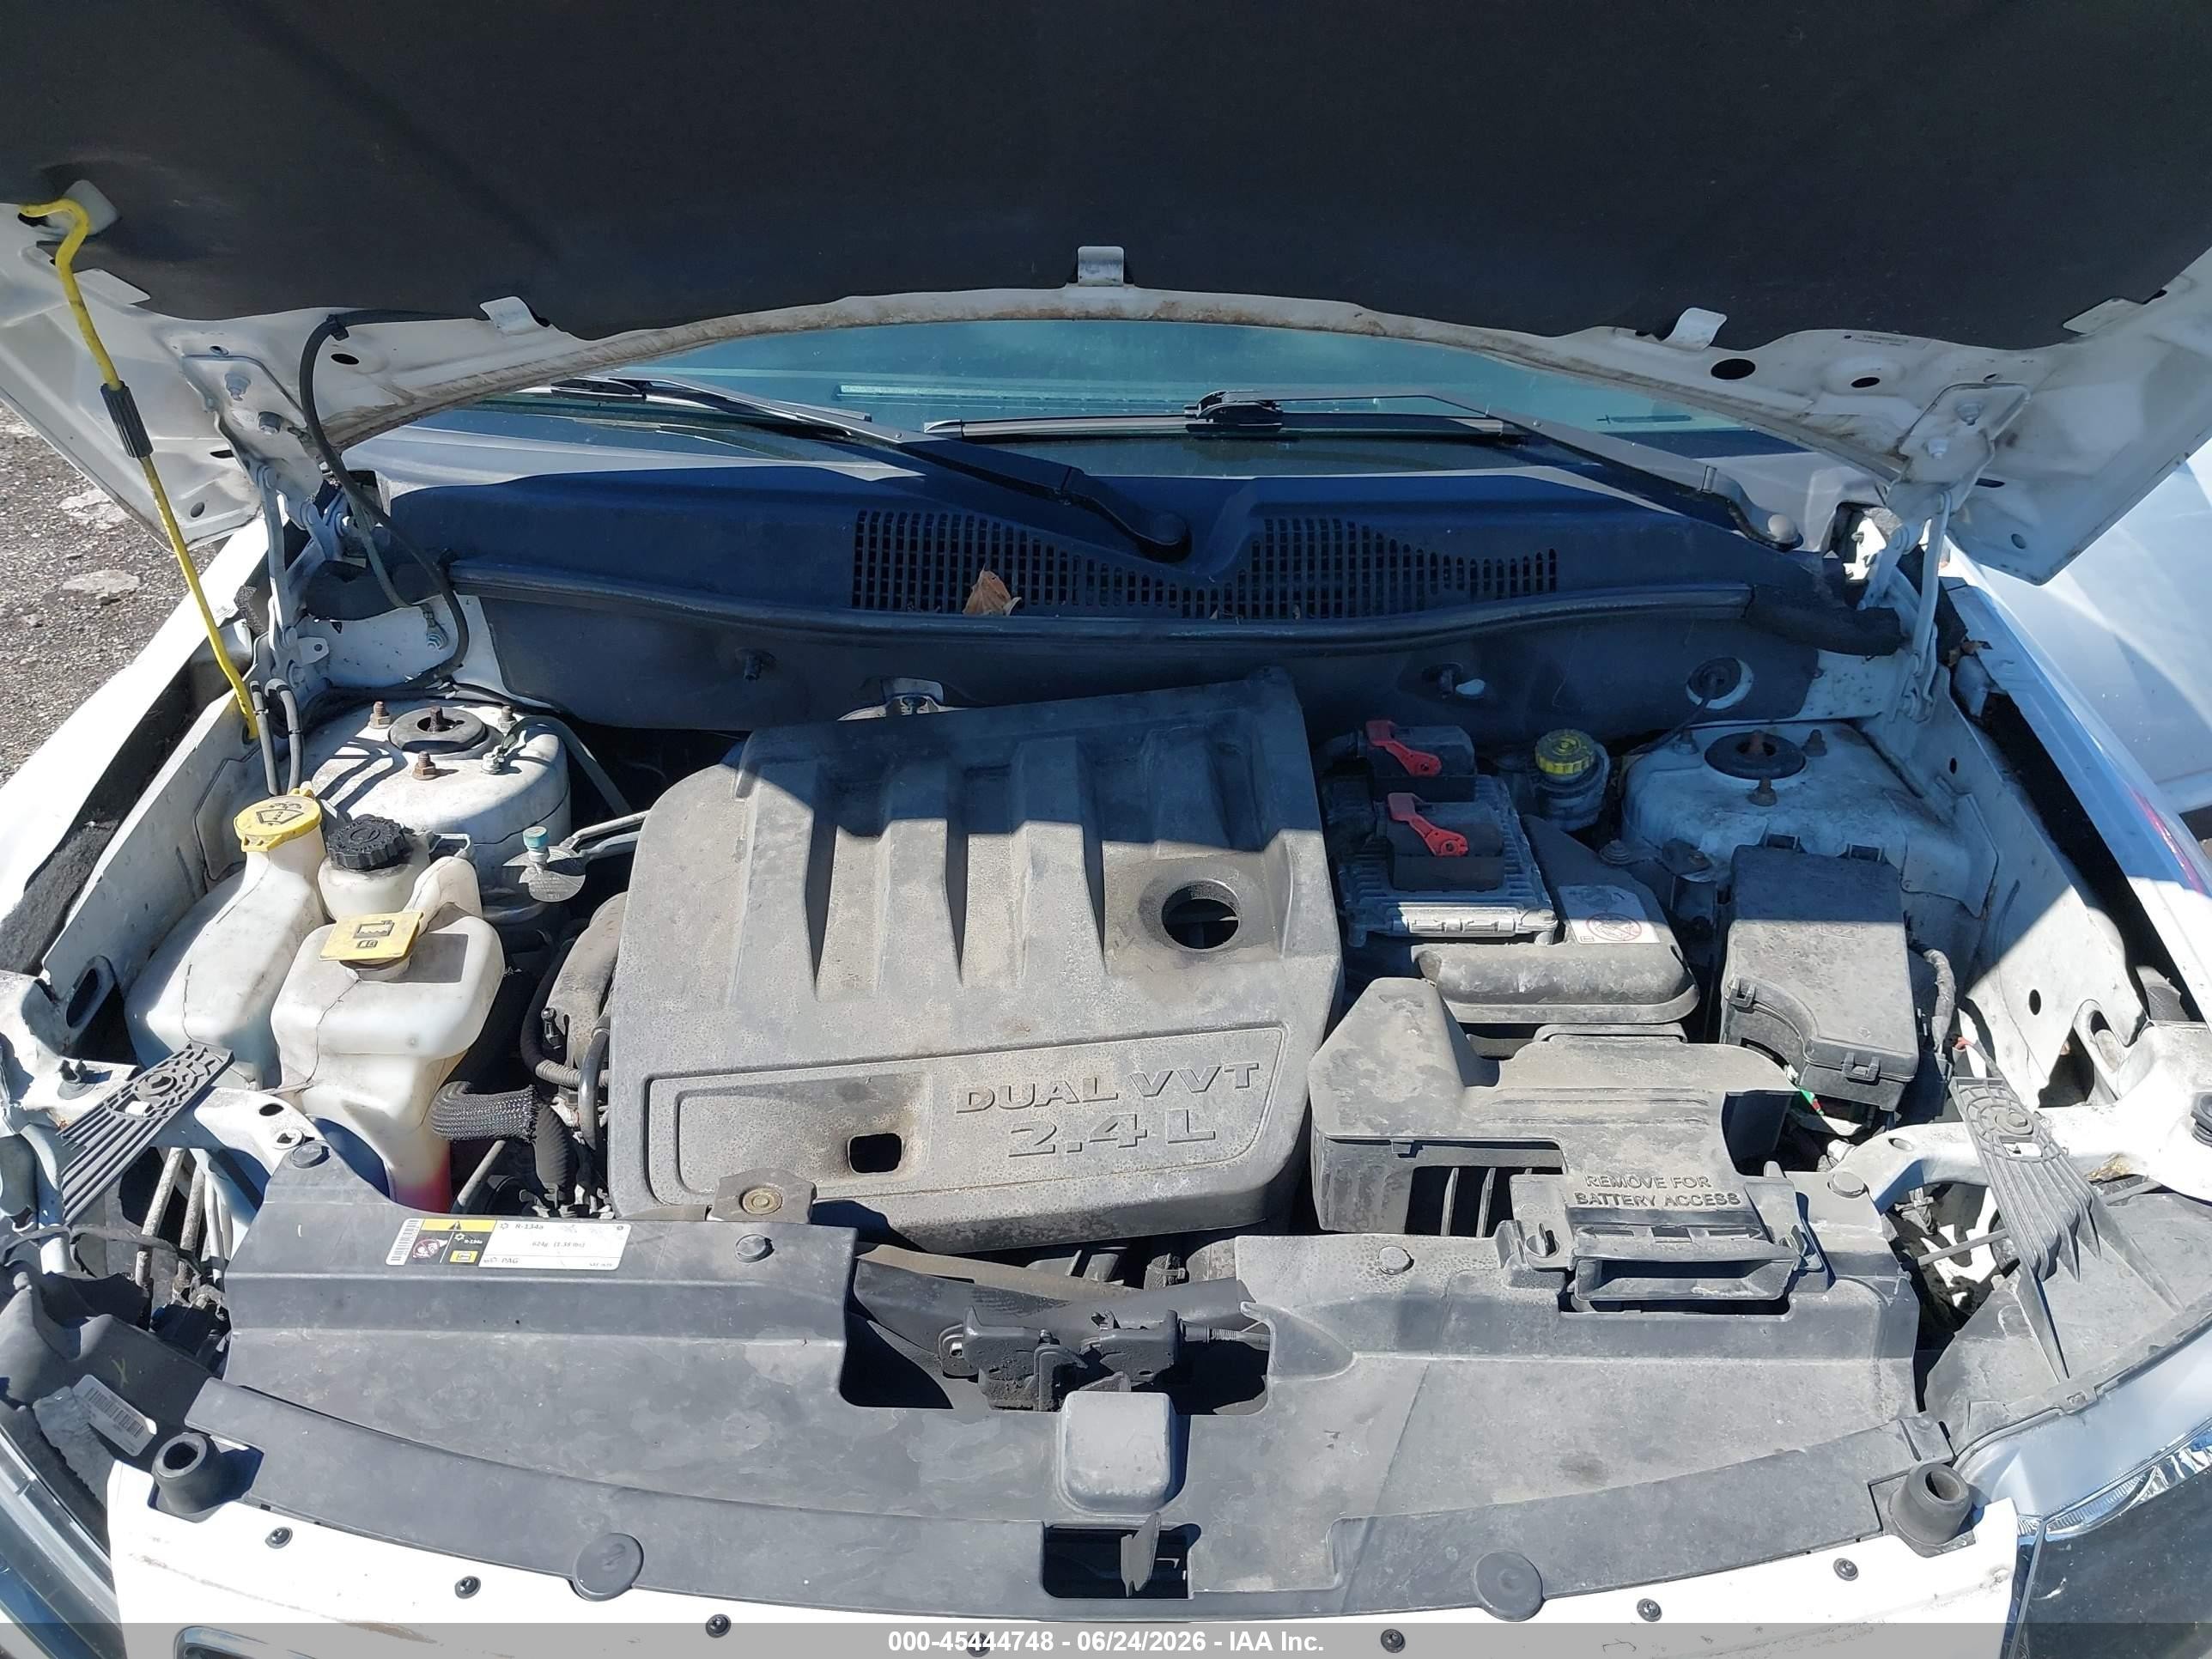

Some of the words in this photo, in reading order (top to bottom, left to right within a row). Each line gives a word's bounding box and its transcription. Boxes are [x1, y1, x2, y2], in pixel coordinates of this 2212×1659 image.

[956, 1077, 1119, 1114] DUAL
[1128, 1062, 1260, 1098] VVT
[1584, 1175, 1668, 1189] REMOVE
[1670, 1176, 1711, 1188] FOR
[1574, 1192, 1656, 1207] BATTERY
[1663, 1192, 1741, 1206] ACCESS
